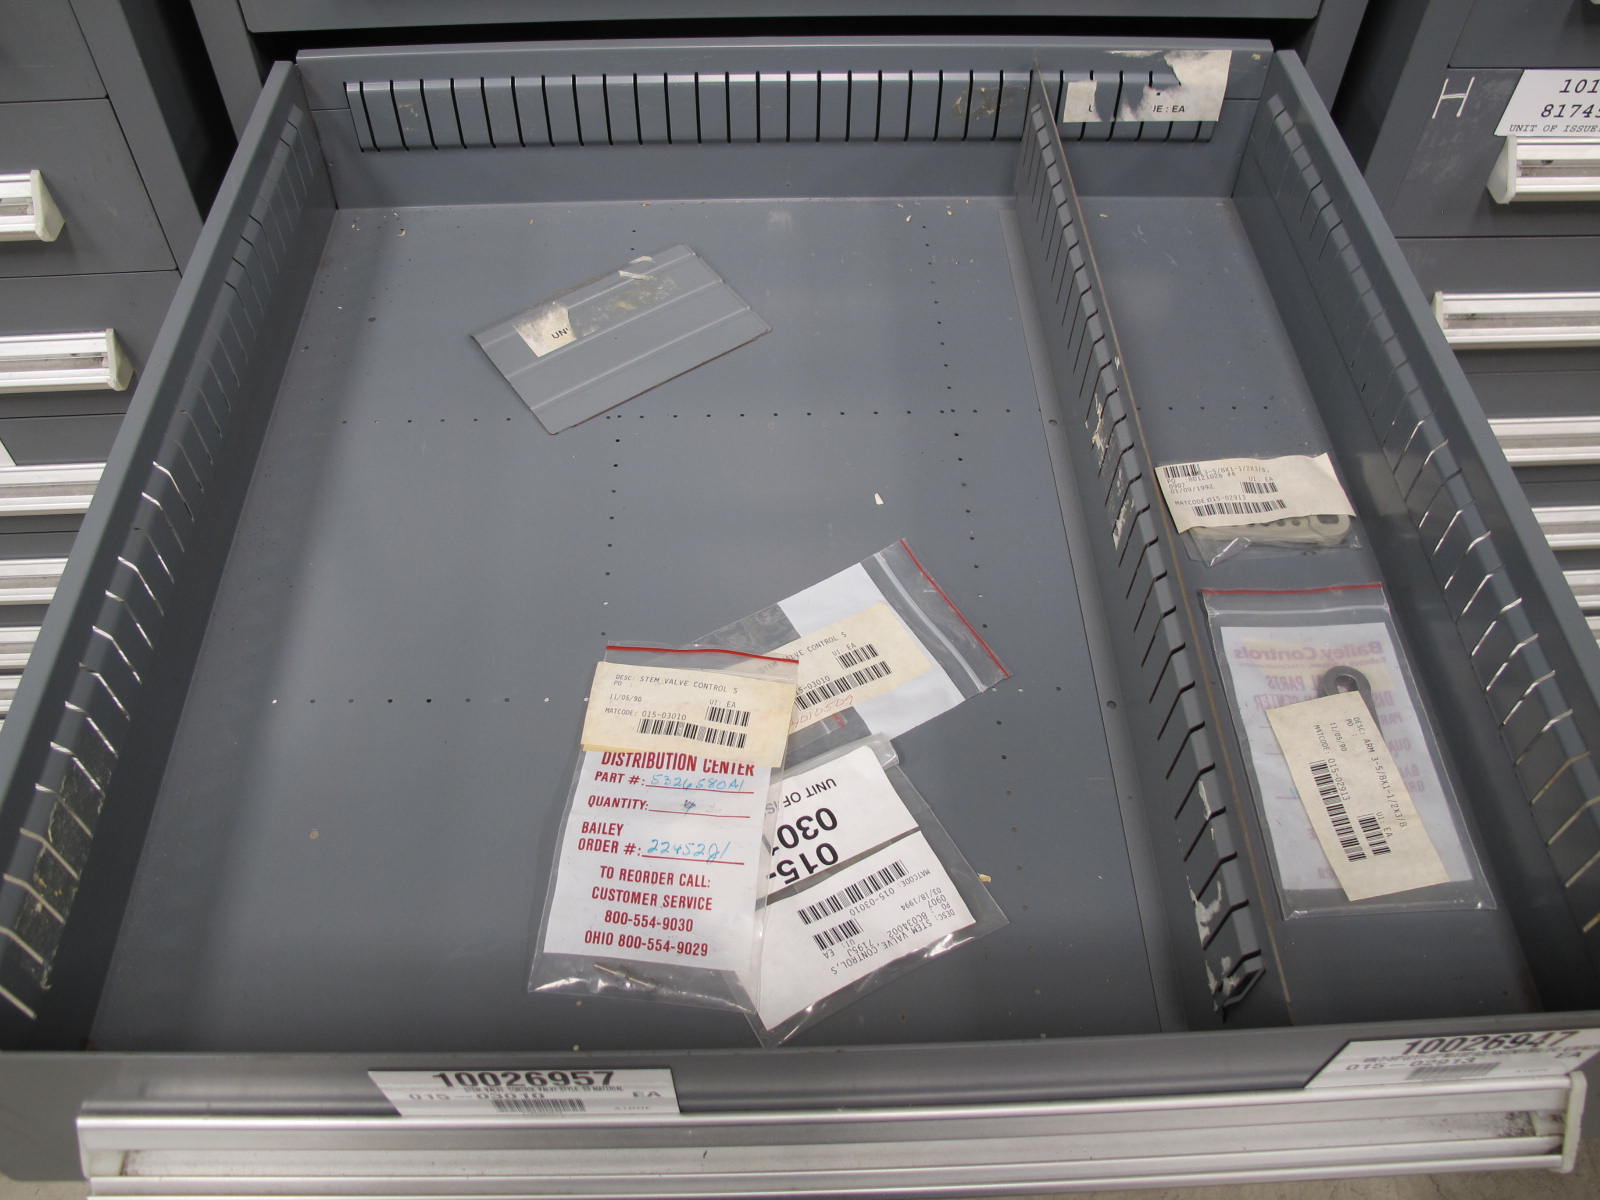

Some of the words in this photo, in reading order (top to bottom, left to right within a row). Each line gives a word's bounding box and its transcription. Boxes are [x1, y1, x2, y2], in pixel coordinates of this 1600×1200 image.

[1432, 76, 1475, 119] H
[640, 675, 660, 684] STEM
[664, 677, 689, 687] VALVE
[693, 681, 728, 693] CONTROL
[795, 675, 831, 695] 15-03010
[641, 710, 687, 721] 015-03010
[1364, 739, 1375, 753] ARM
[601, 752, 698, 772] DISTRIBUTION
[703, 758, 755, 777] CENTER
[594, 771, 625, 785] PART
[805, 778, 837, 798] UNIT
[588, 795, 649, 811] QUANTITY:
[783, 791, 802, 808] OF
[581, 821, 624, 837] BAILEY
[578, 838, 619, 854] ORDER
[768, 843, 839, 885] 015-
[600, 865, 614, 880] TO
[619, 869, 674, 885] REORDER
[679, 874, 711, 888] CALL:
[591, 886, 657, 906] CUSTOMER
[663, 895, 713, 911] SERVICE
[849, 888, 895, 916] 015-03010
[927, 894, 947, 909] 0907
[604, 910, 694, 933] 800-554-9030
[584, 930, 614, 946] OHIO
[618, 934, 708, 957] 800-554-9029
[822, 948, 835, 959] EA
[1402, 1030, 1580, 1056] 10026947
[432, 1071, 614, 1088] 10026957
